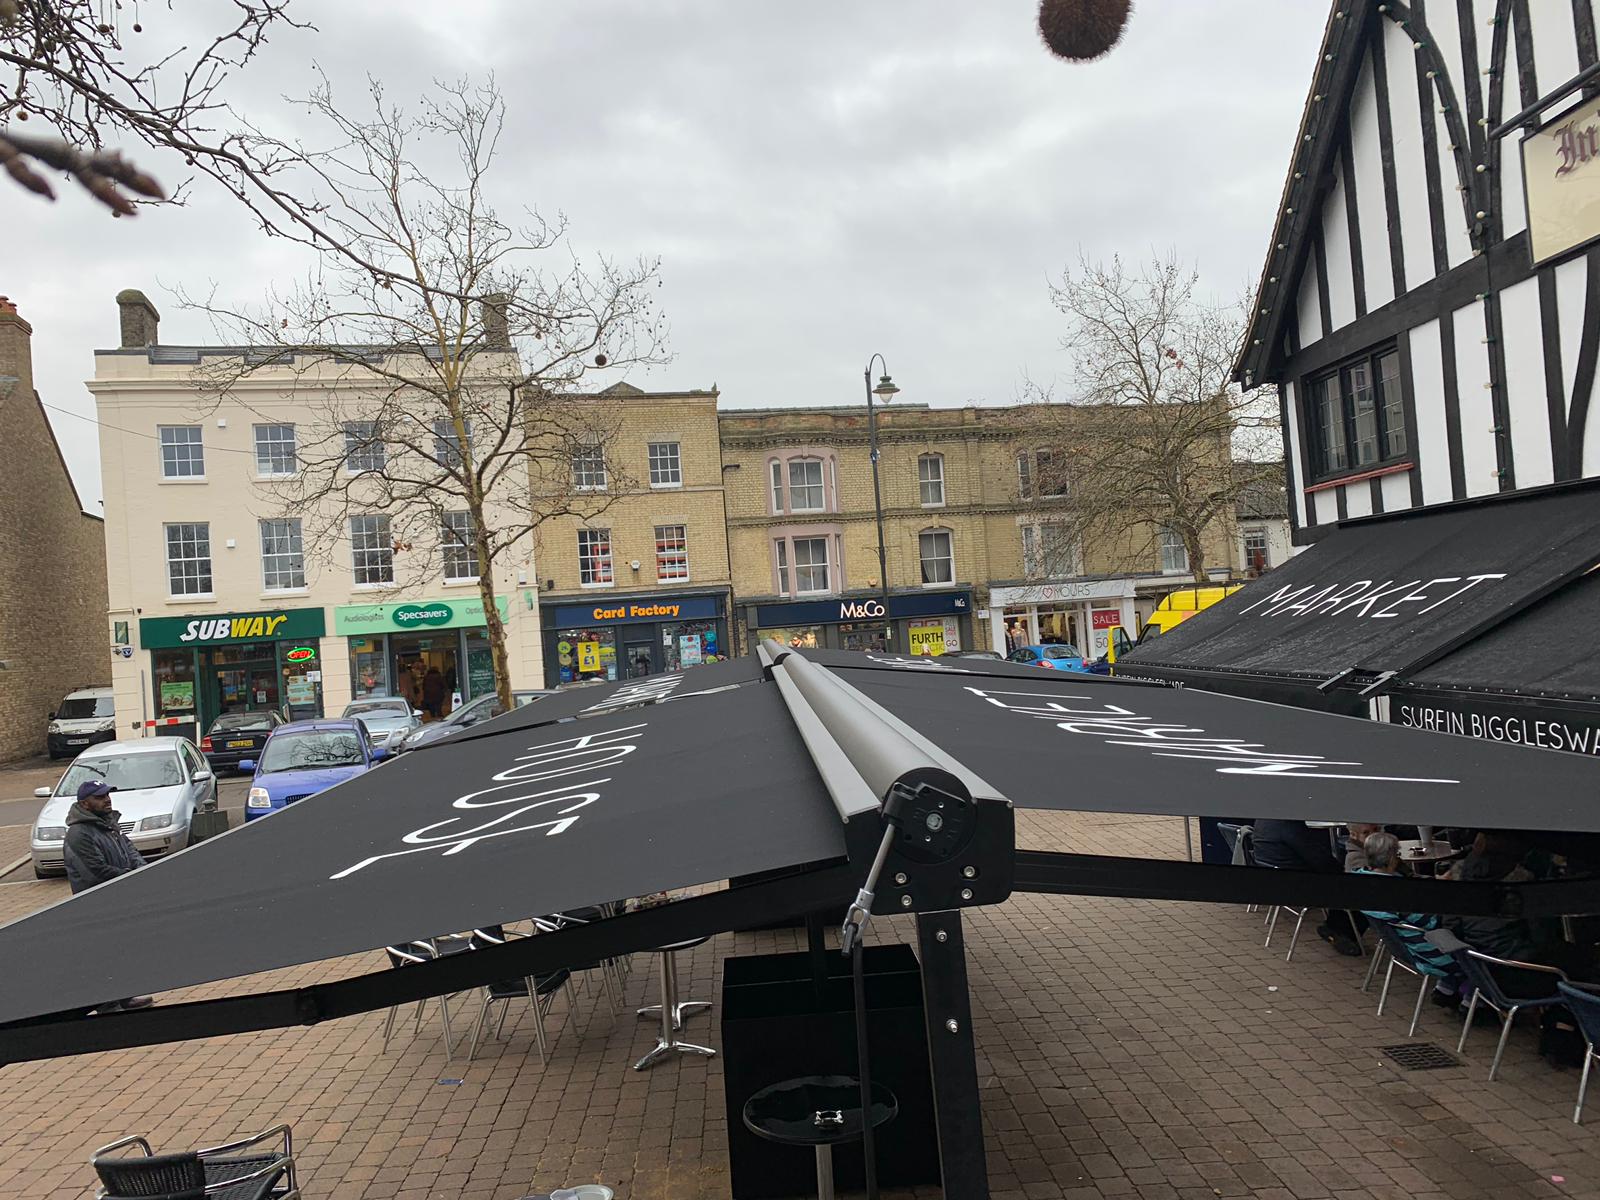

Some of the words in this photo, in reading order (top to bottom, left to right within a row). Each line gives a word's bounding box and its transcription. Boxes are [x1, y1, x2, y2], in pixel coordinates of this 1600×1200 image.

[1238, 573, 1508, 618] MARKET
[398, 609, 448, 621] Specsavers
[593, 607, 626, 620] Card
[630, 604, 680, 617] Factory
[840, 600, 885, 619] M&Co
[1093, 614, 1119, 625] SALE
[179, 614, 288, 642] SUBWAY
[585, 644, 592, 653] 5
[946, 639, 958, 647] GO
[288, 650, 311, 659] OPEN
[1401, 705, 1465, 735] SURFIN
